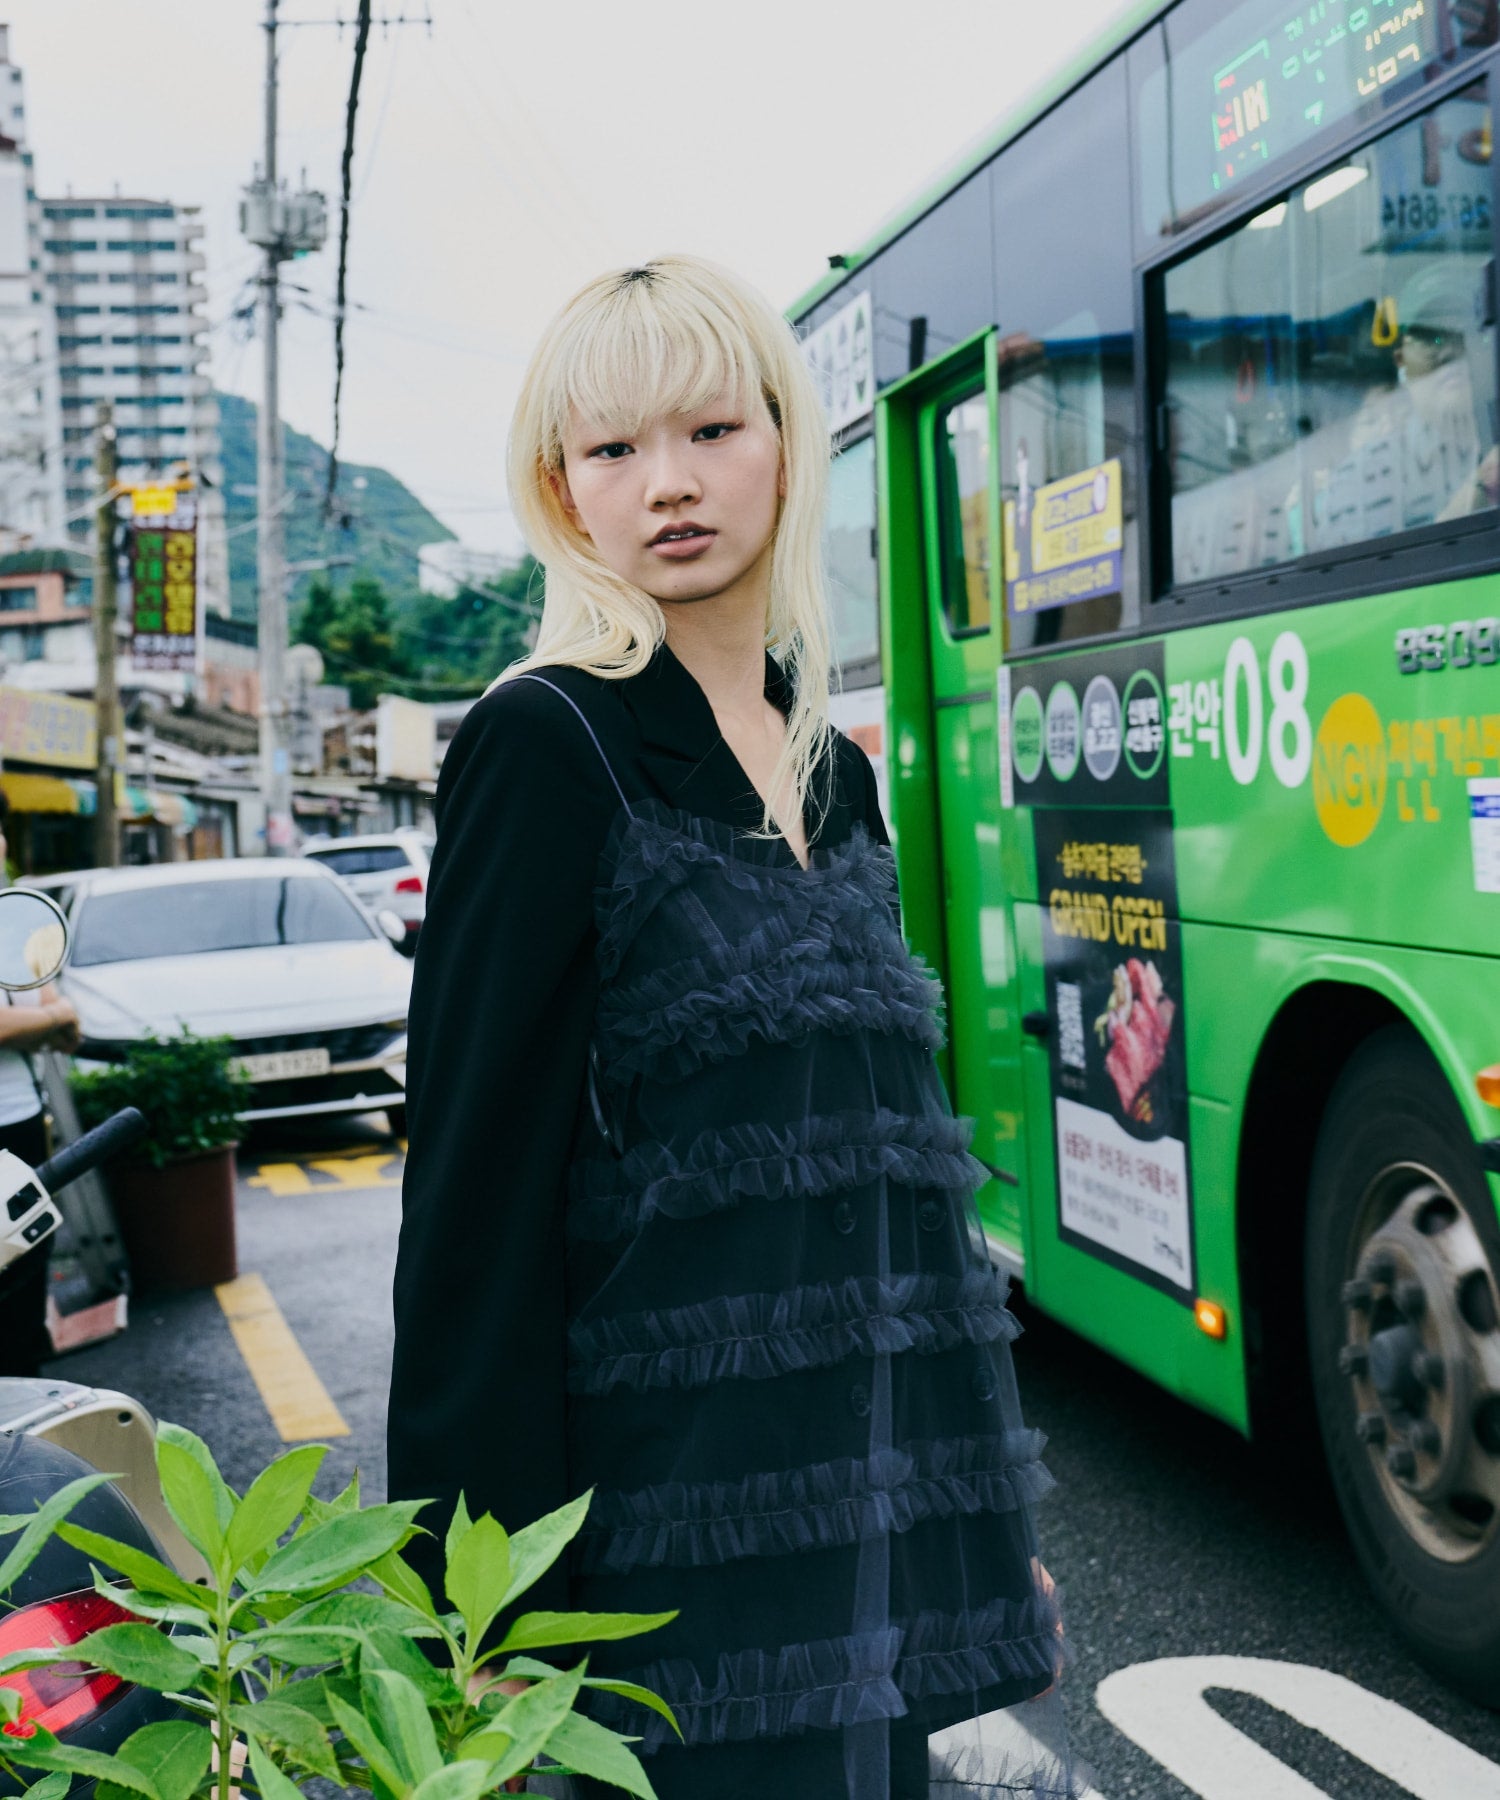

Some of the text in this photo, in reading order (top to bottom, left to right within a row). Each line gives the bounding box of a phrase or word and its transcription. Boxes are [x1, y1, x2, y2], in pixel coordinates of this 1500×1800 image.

[1167, 678, 1221, 760] 관악
[1223, 630, 1313, 789] 08
[1316, 738, 1386, 810] NGV
[1049, 888, 1167, 952] GRAND OPEN
